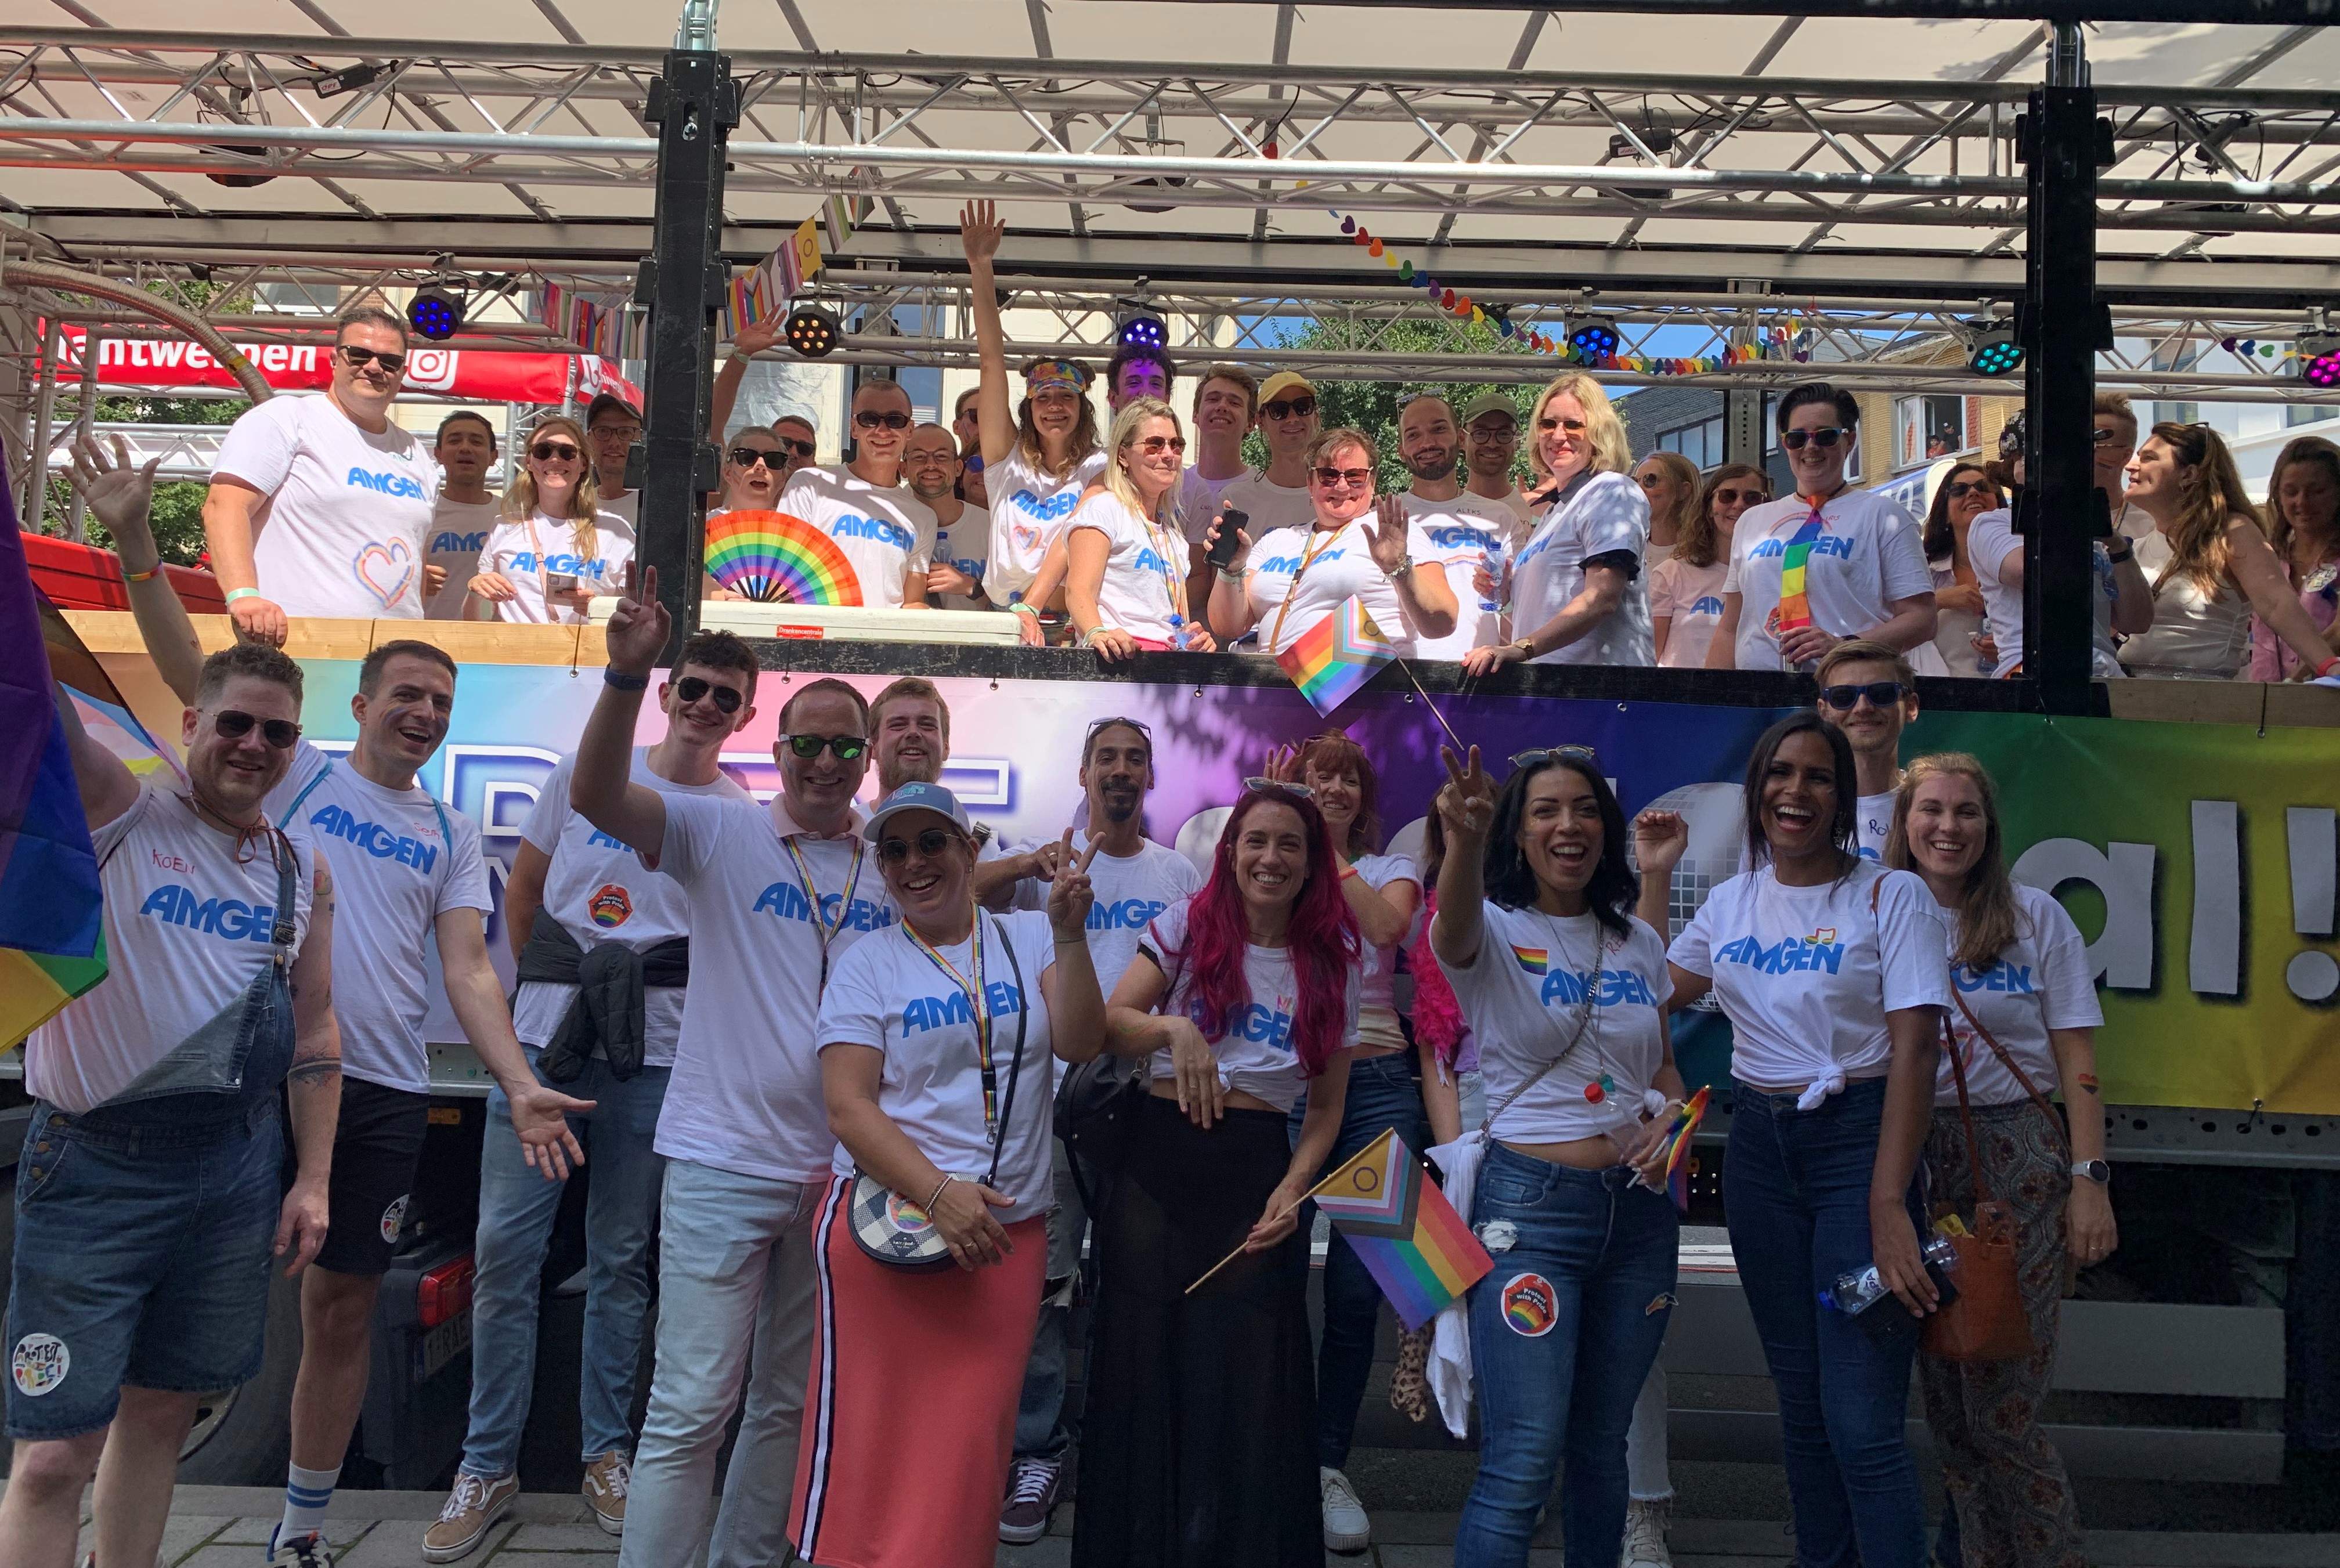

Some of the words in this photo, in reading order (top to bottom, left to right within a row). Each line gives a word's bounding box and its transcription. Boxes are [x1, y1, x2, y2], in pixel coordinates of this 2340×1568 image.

[348, 467, 427, 502] AMGEN
[832, 514, 916, 554] AMGEN
[1426, 528, 1491, 550] MGEN
[779, 627, 822, 635] Drankencentrale
[310, 804, 438, 875] AMGEN
[152, 848, 195, 875] KOEN
[139, 884, 278, 944] AMGE
[611, 901, 624, 909] Pride
[1714, 935, 1845, 976] AMGEN
[1523, 1288, 1547, 1304] Protest
[1866, 1272, 1883, 1296] SPA
[1533, 1298, 1547, 1314] Pride
